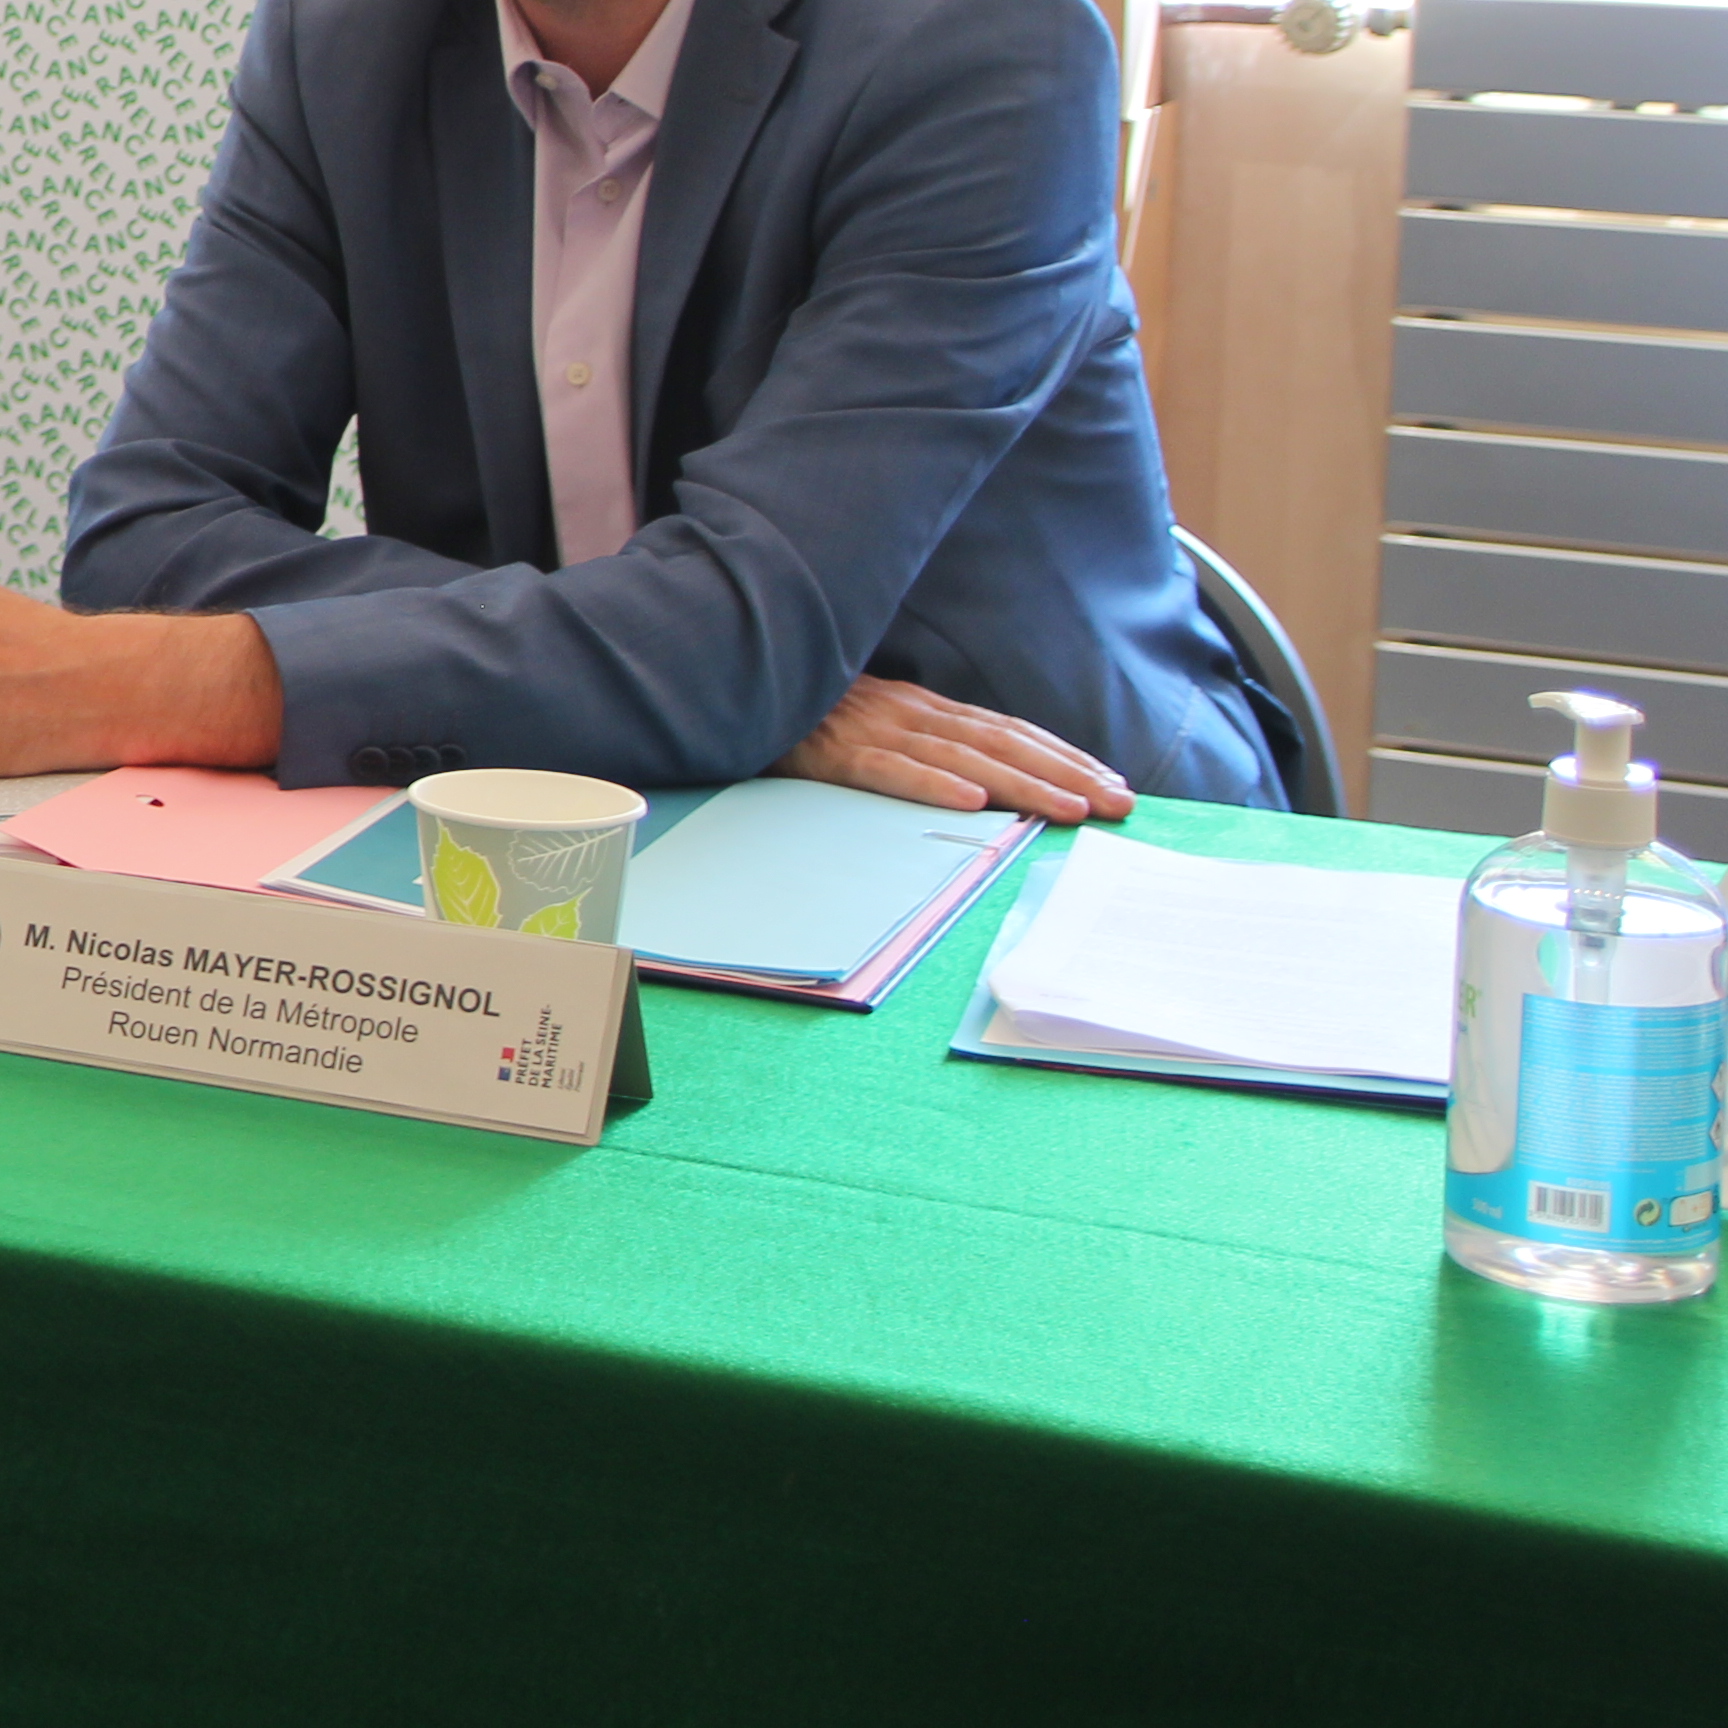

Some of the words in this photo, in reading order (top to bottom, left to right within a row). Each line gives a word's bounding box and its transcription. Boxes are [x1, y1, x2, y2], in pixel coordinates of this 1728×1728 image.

[23, 923, 57, 951] M.
[66, 929, 175, 968] Nicolas
[183, 946, 501, 1017] MAYER-ROSSIGNOL
[61, 966, 192, 1009] Président
[199, 988, 235, 1015] de
[242, 993, 268, 1021] la
[276, 998, 419, 1043] Métropole
[535, 1003, 552, 1045] SEINE-
[107, 1010, 199, 1048] Rouen
[207, 1026, 364, 1074] Normandie
[514, 1037, 532, 1085] PRÉFET
[532, 1048, 544, 1066] LA
[540, 1023, 563, 1089] MARITIME
[528, 1069, 541, 1087] DE
